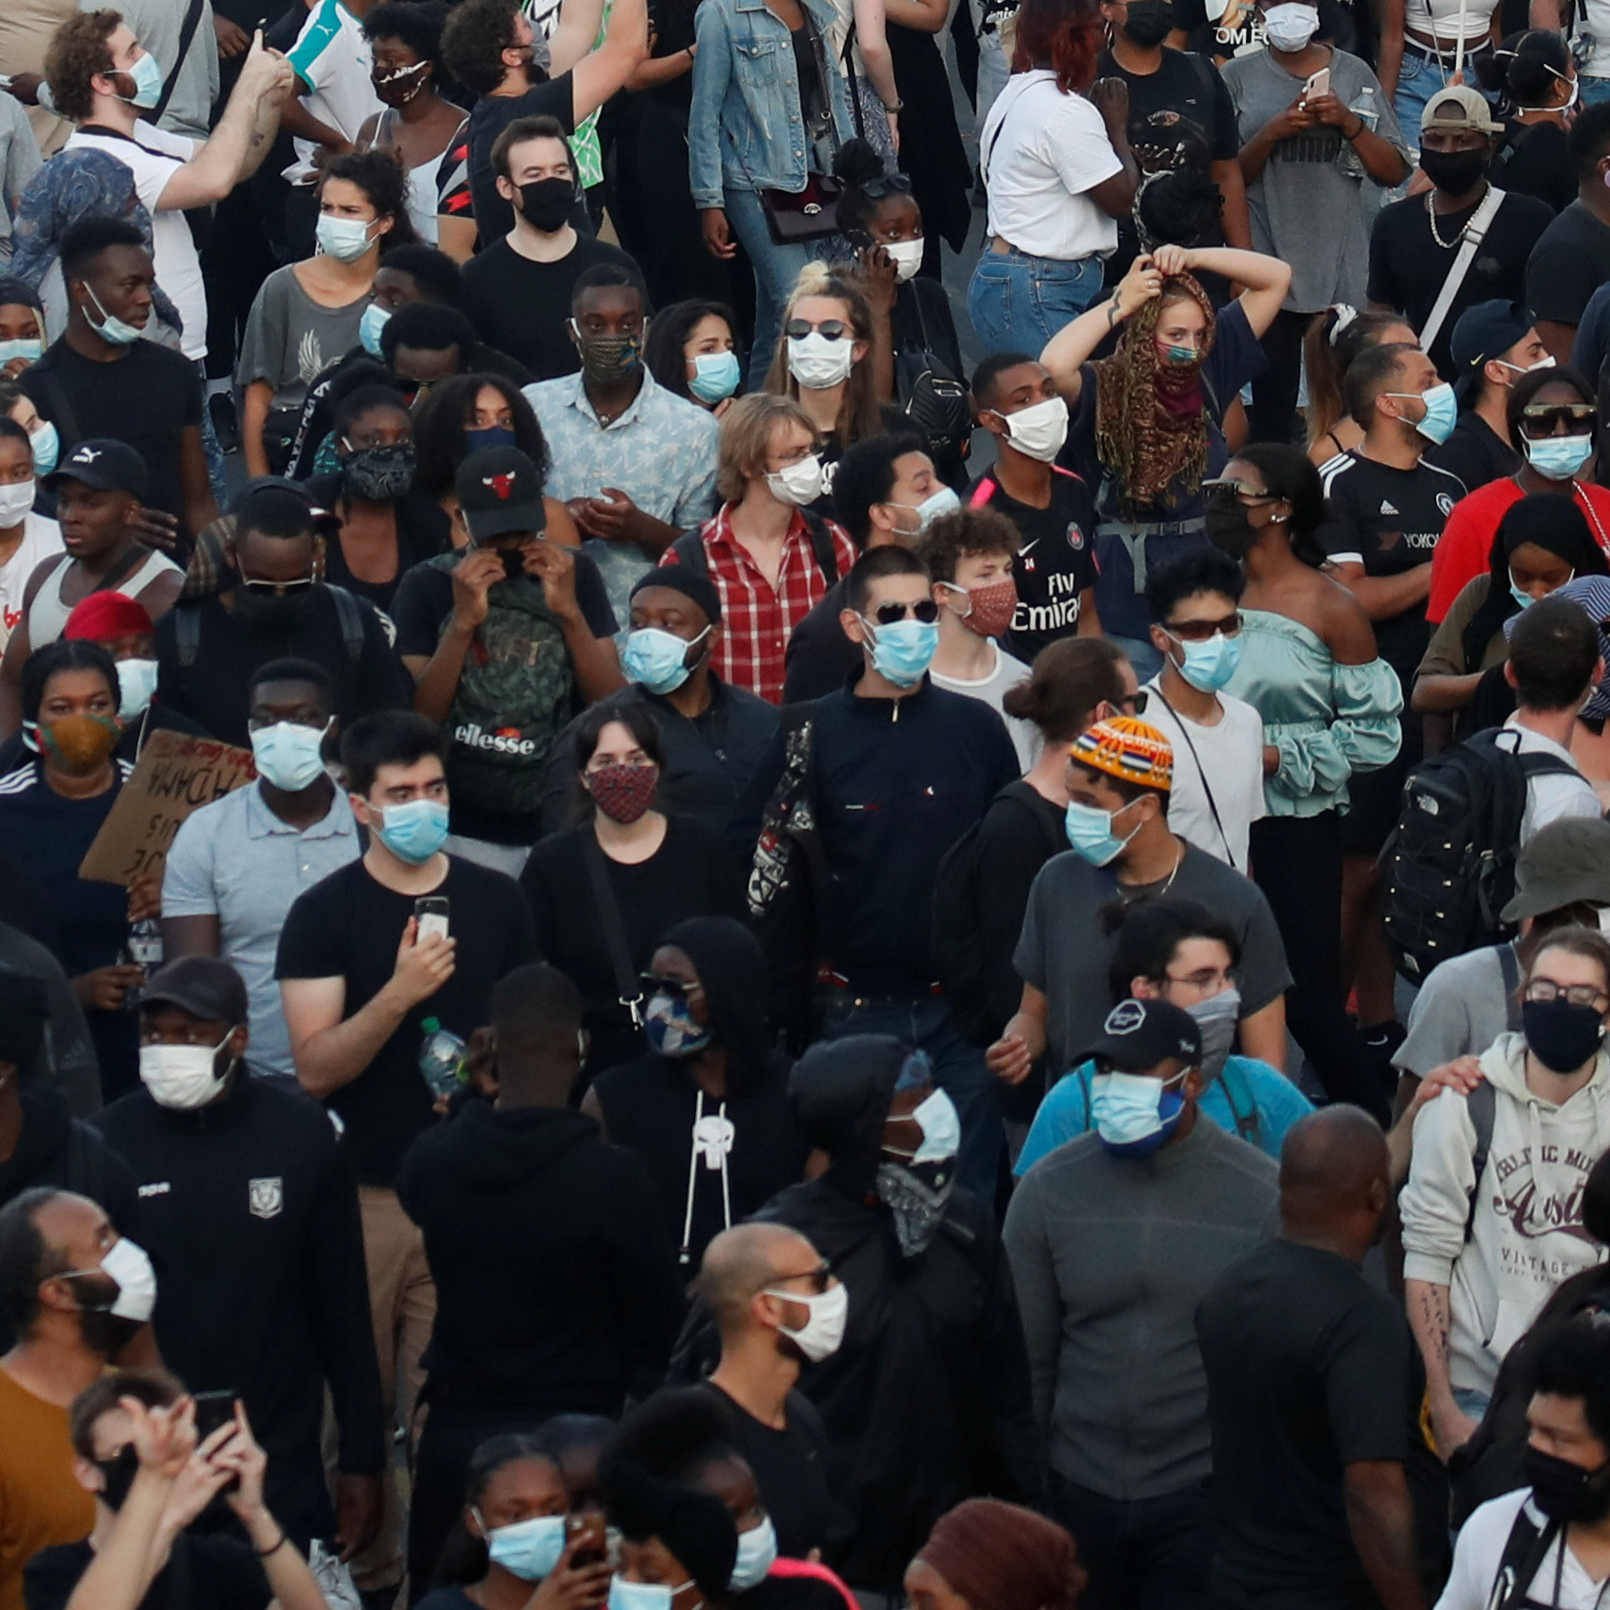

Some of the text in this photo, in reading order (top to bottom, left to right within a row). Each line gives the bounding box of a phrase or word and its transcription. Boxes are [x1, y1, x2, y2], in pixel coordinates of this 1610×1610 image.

[1215, 26, 1248, 45] OM
[1047, 572, 1075, 597] Fly
[1009, 596, 1081, 632] Emira
[454, 723, 535, 756] ellesse
